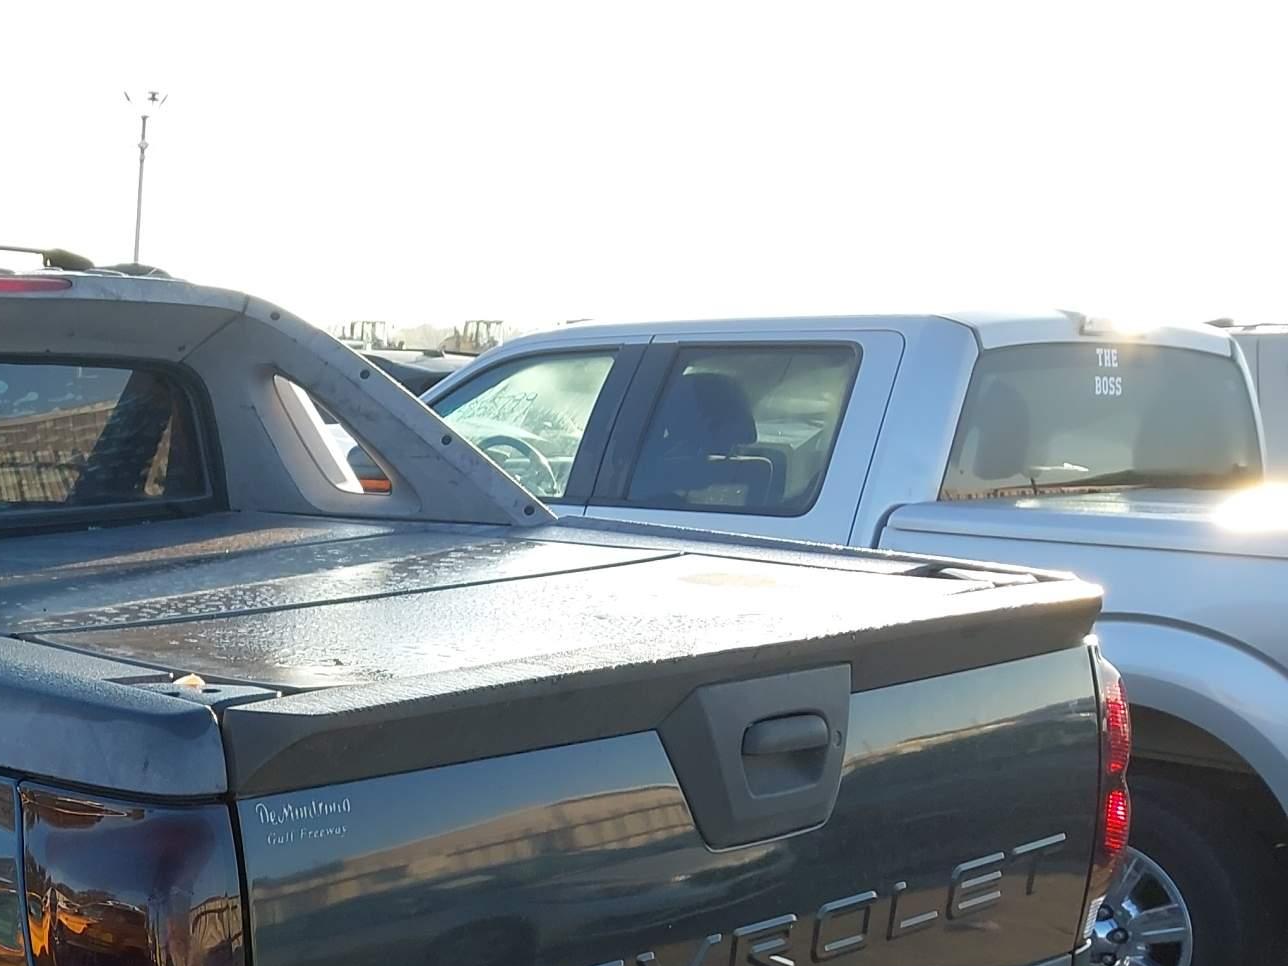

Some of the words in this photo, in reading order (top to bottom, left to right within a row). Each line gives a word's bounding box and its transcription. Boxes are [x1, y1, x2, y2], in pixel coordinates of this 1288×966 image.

[1095, 347, 1119, 368] THE
[1095, 376, 1122, 396] BOSS
[300, 825, 347, 839] Freeway
